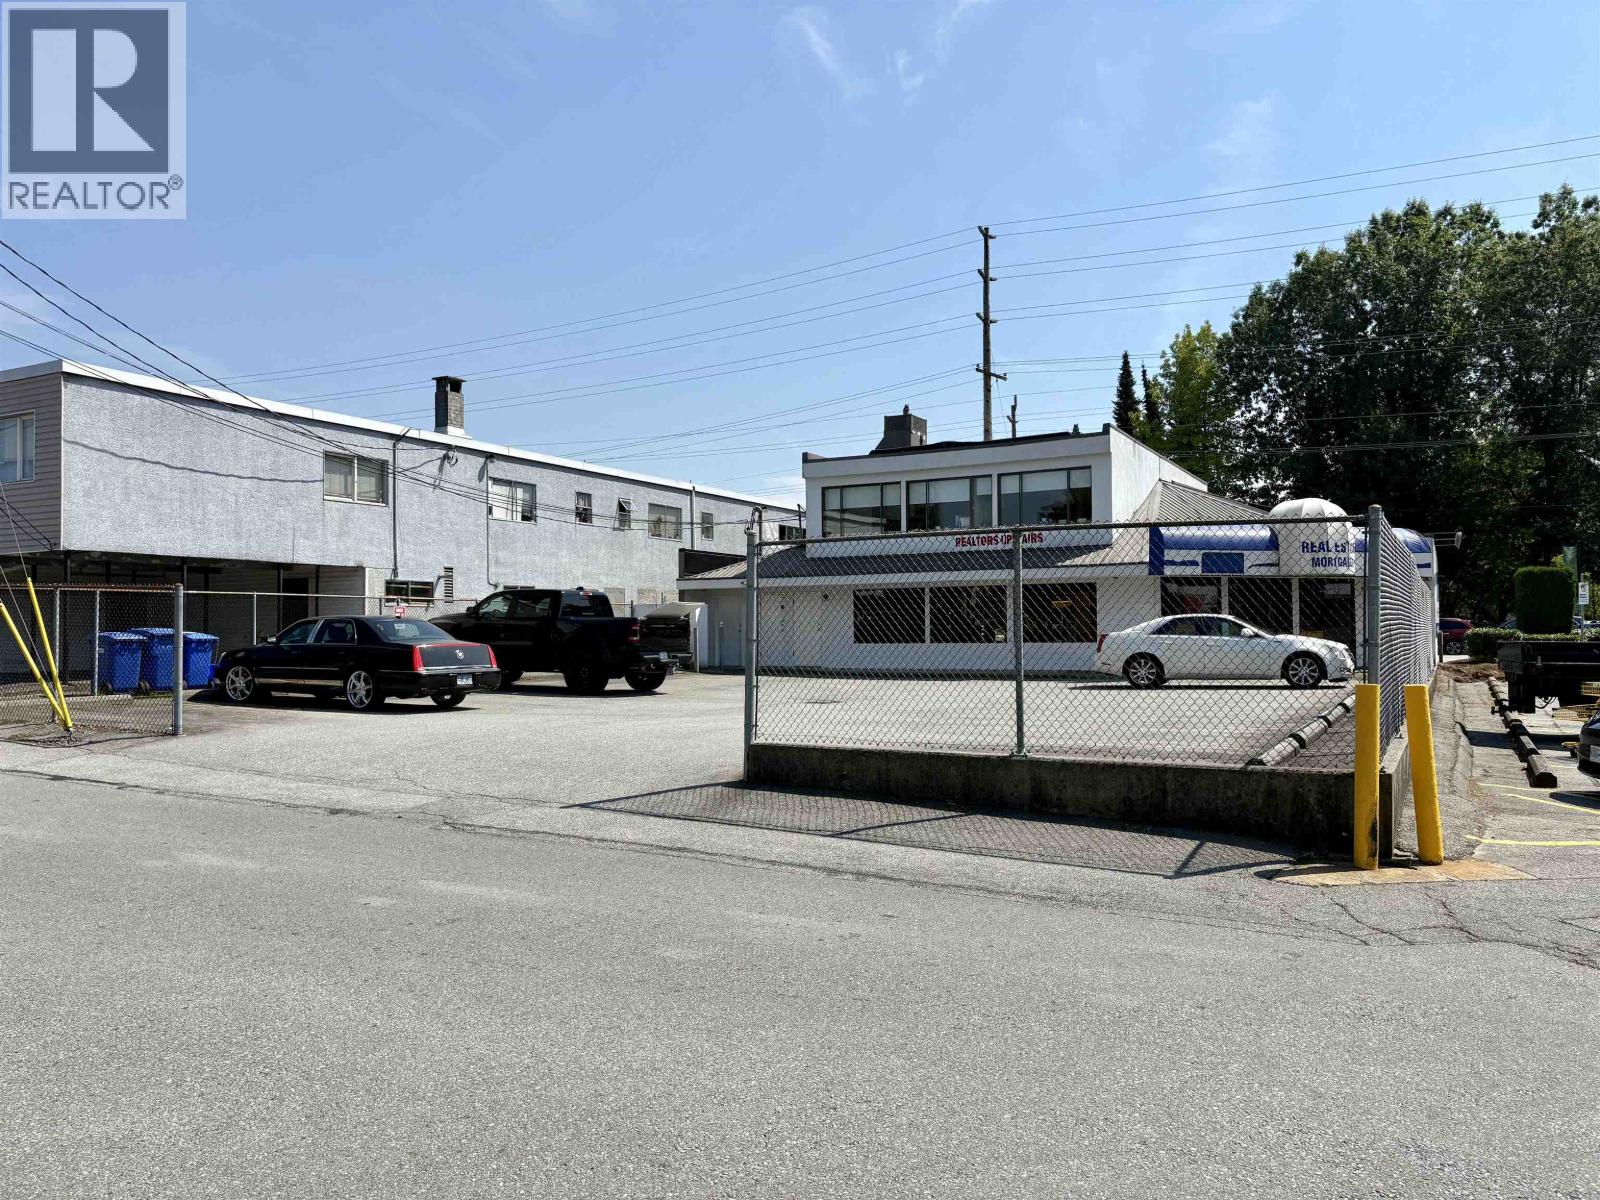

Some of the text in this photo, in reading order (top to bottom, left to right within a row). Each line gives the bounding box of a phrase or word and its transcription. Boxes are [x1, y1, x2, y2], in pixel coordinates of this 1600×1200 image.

[955, 532, 1044, 547] REALTORS UPAIRS
[1301, 540, 1332, 553] REAL
